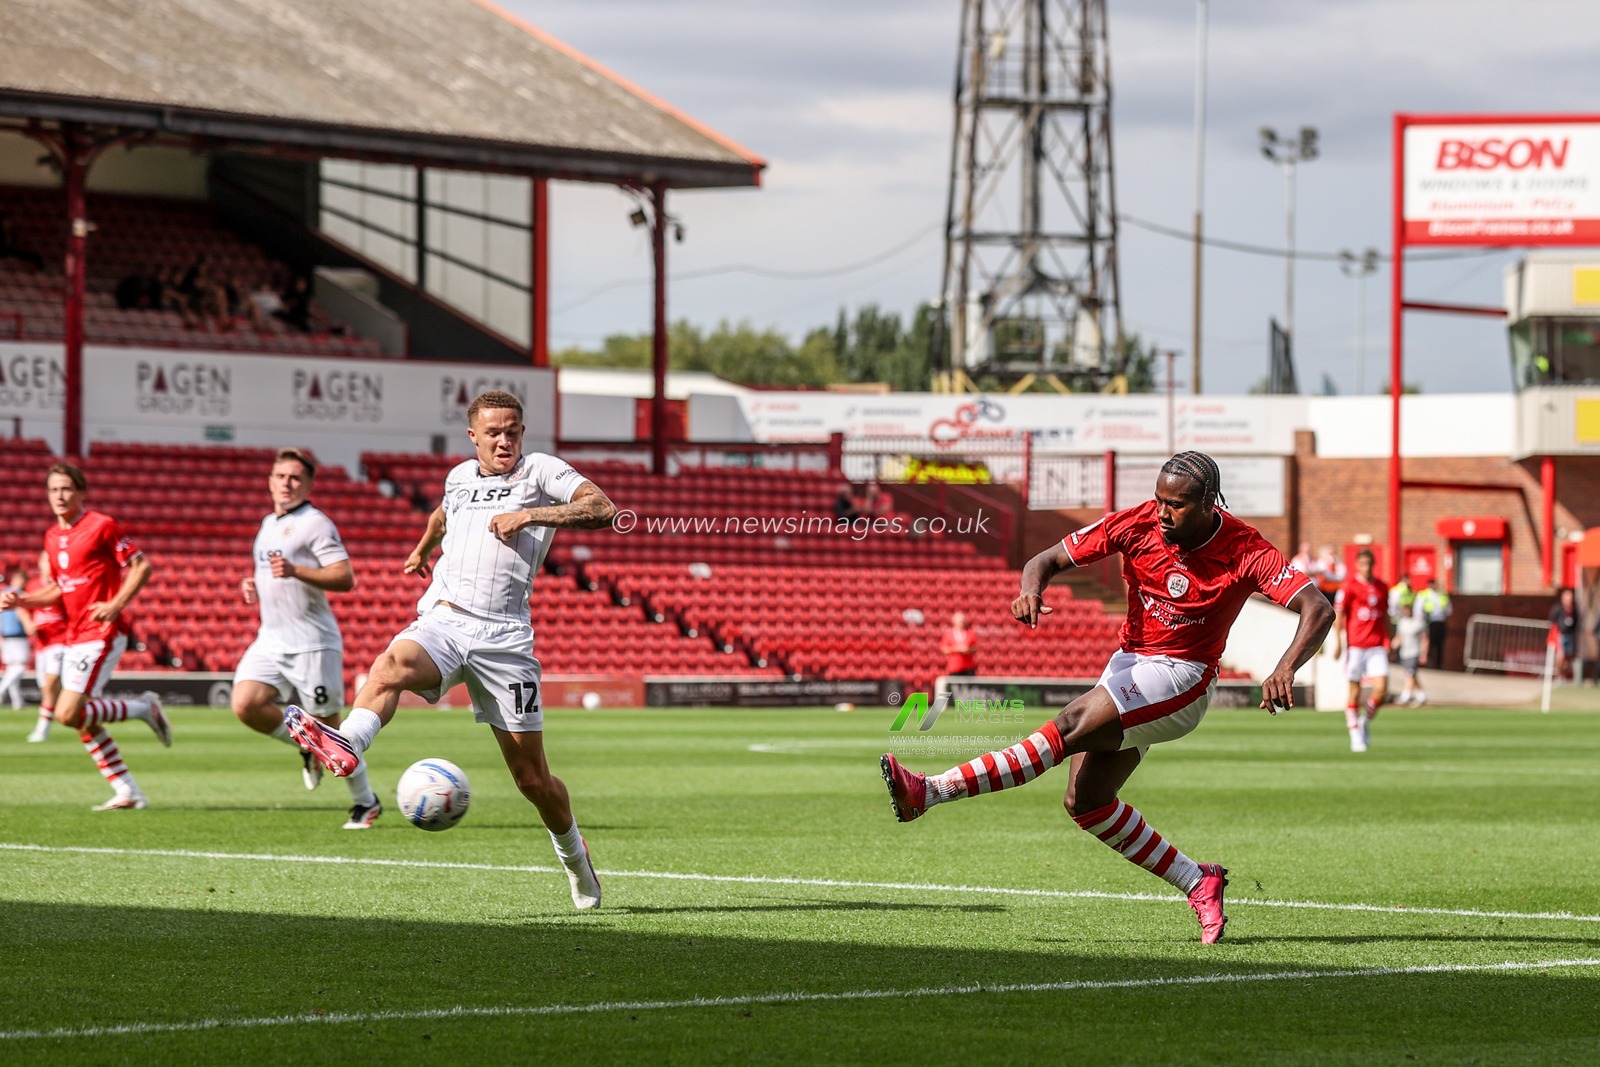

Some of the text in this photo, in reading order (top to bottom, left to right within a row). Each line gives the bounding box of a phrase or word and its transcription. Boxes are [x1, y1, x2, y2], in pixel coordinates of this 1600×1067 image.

[137, 360, 232, 396] PAGEN
[292, 368, 383, 403] PAGEN
[470, 488, 512, 502] LSP
[314, 685, 329, 706] 8
[508, 681, 539, 714] 12
